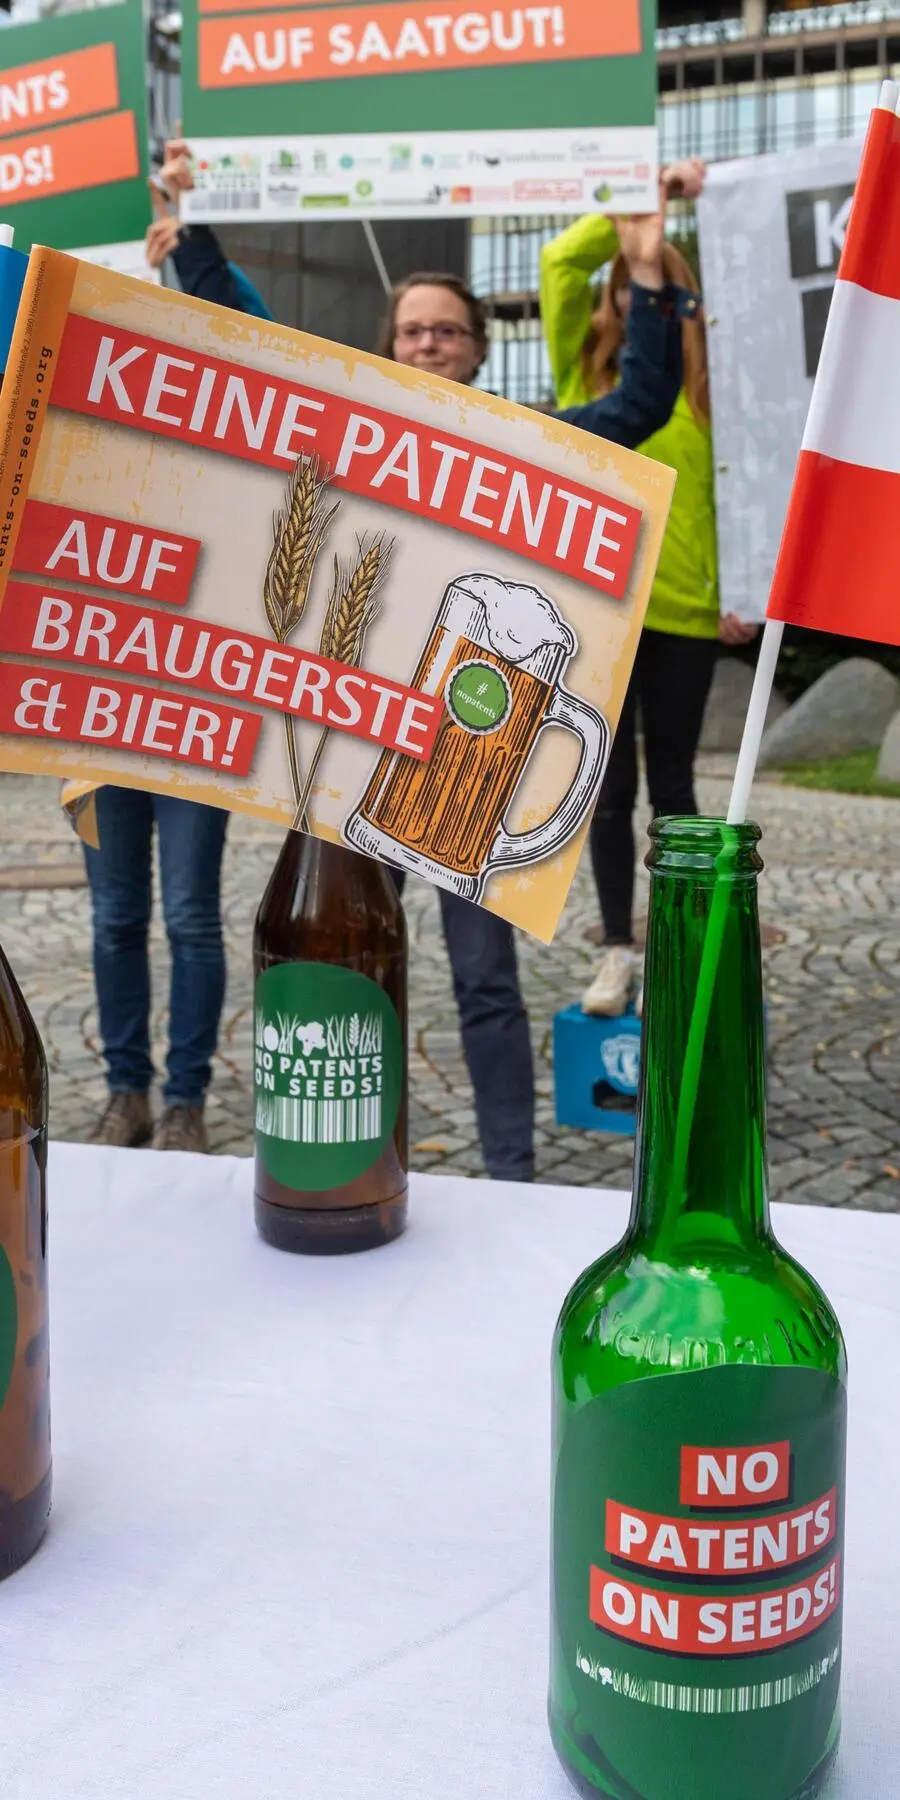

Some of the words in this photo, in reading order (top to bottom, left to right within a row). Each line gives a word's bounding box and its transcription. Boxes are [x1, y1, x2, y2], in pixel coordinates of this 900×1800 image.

[220, 27, 313, 75] AUF
[328, 5, 566, 65] SAATGUT!
[0, 346, 52, 567] ents-on-seeds.org
[87, 336, 325, 463] KEINE
[334, 412, 627, 582] PATENTE
[45, 519, 183, 591] AUF
[31, 596, 435, 754] BRAUGERSTE
[456, 689, 497, 719] nopatents
[14, 678, 67, 732] &
[79, 686, 244, 767] BIER!
[255, 1047, 273, 1070] NO
[279, 1055, 383, 1077] PATENTS
[255, 1069, 275, 1091] ON
[289, 1075, 382, 1097] SEEDS!
[696, 1451, 779, 1495] NO
[619, 1500, 831, 1570] PATENTS
[602, 1581, 679, 1640] ON
[697, 1562, 836, 1644] SEEDS!
